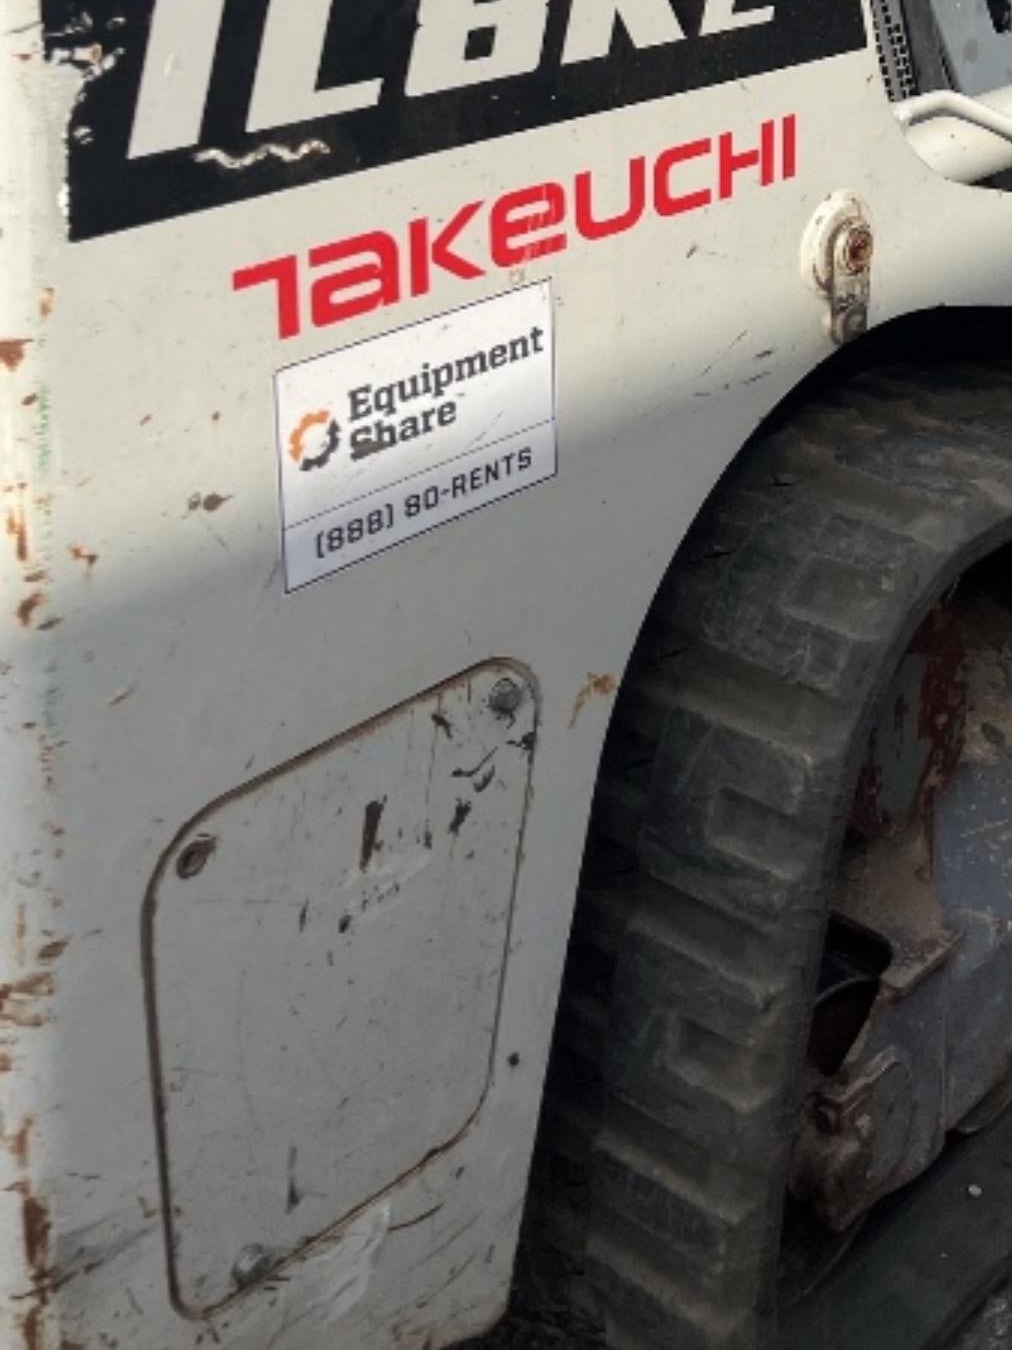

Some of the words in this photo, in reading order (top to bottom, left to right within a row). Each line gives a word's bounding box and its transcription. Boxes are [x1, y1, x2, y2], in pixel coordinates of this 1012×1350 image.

[347, 326, 544, 423] Equipment
[349, 400, 457, 462] Share
[315, 503, 395, 558] (888)
[403, 447, 533, 518] 80-RENTS
